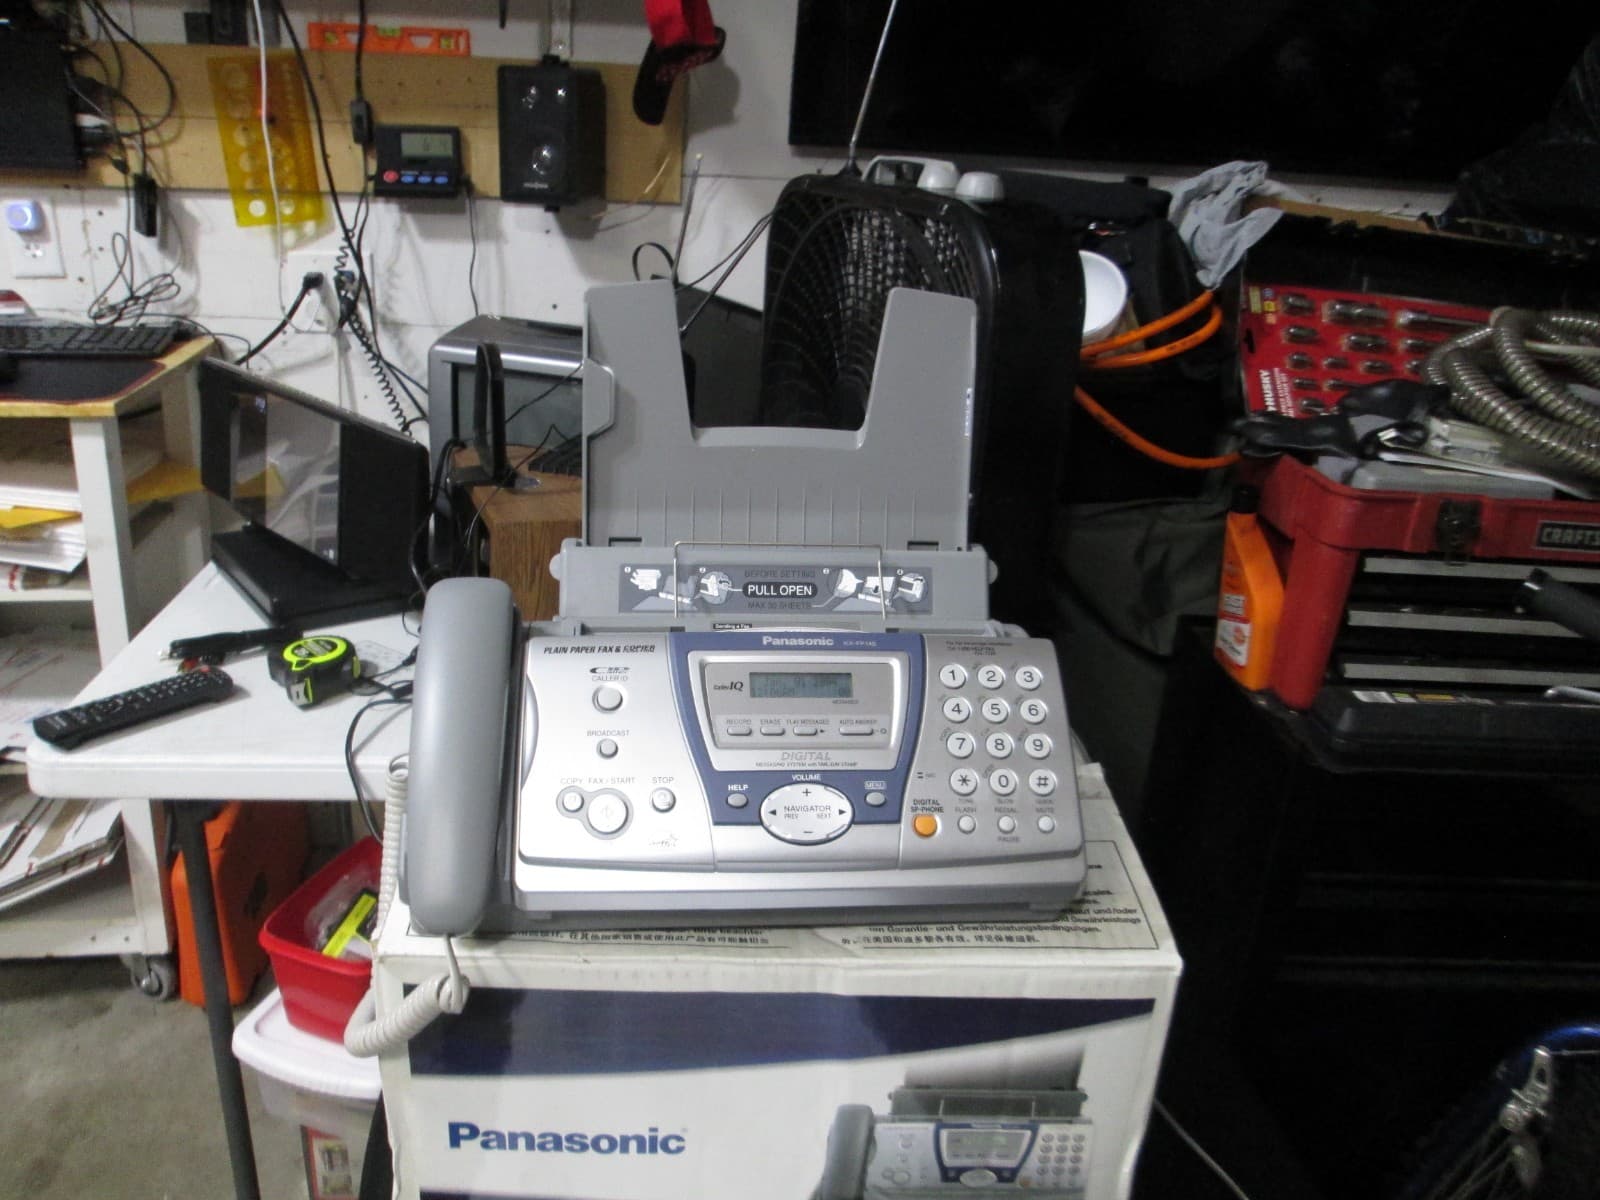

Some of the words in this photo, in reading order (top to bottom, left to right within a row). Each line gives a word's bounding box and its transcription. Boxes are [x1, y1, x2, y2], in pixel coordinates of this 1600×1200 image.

[747, 585, 778, 596] PULL
[780, 585, 812, 596] OPEN
[762, 635, 834, 646] Panasonic
[543, 646, 568, 654] PLAIN
[569, 646, 596, 654] PAPER
[597, 645, 613, 653] FAX
[948, 670, 956, 681] 1
[985, 670, 997, 682] 2
[1023, 671, 1034, 683] 3
[951, 703, 962, 715] 4
[990, 704, 1001, 716] 5
[1028, 704, 1039, 717] 6
[955, 737, 966, 750] 7
[994, 738, 1005, 751] 8
[1032, 739, 1043, 751] 9
[780, 751, 832, 761] DIGITAL
[652, 776, 674, 784] STOP
[864, 781, 887, 790] MENU
[998, 775, 1009, 788] 0
[935, 924, 955, 932] und
[448, 1121, 686, 1155] Panasonic
